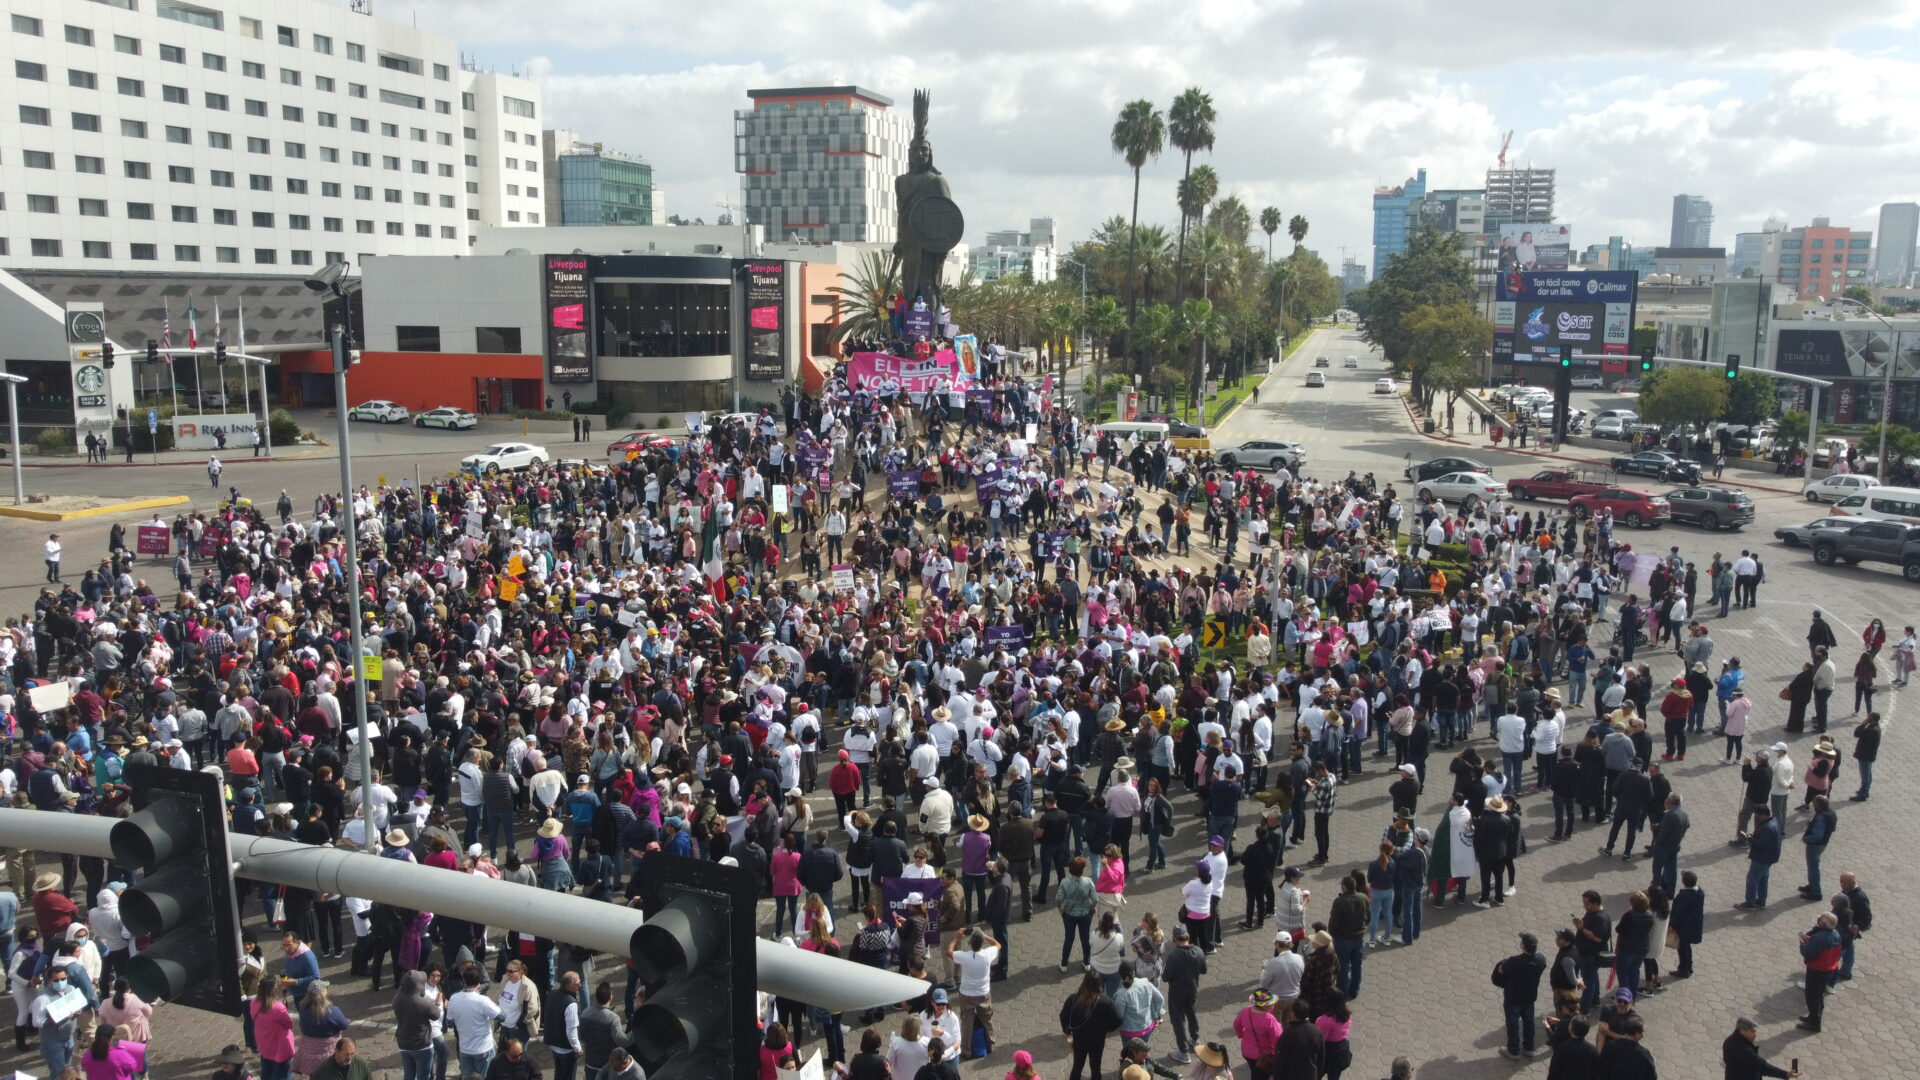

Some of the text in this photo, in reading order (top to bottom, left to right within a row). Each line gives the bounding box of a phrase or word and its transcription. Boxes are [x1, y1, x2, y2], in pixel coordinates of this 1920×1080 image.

[549, 260, 587, 271] Liverpool
[749, 264, 782, 274] Liverpool
[553, 271, 583, 282] Tijuana
[752, 275, 779, 286] Tijuana
[1533, 279, 1545, 287] Tan
[1546, 278, 1561, 287] fácil
[1598, 282, 1627, 292] Calimax
[1537, 287, 1550, 296] dar
[1560, 287, 1574, 296] like.
[1571, 315, 1594, 329] SGT
[875, 359, 898, 374] EL
[919, 359, 949, 371] IN
[858, 371, 967, 392] NO SE TOA
[1839, 387, 1851, 414] PISOS
[201, 424, 228, 435] REL
[231, 424, 253, 434] INN
